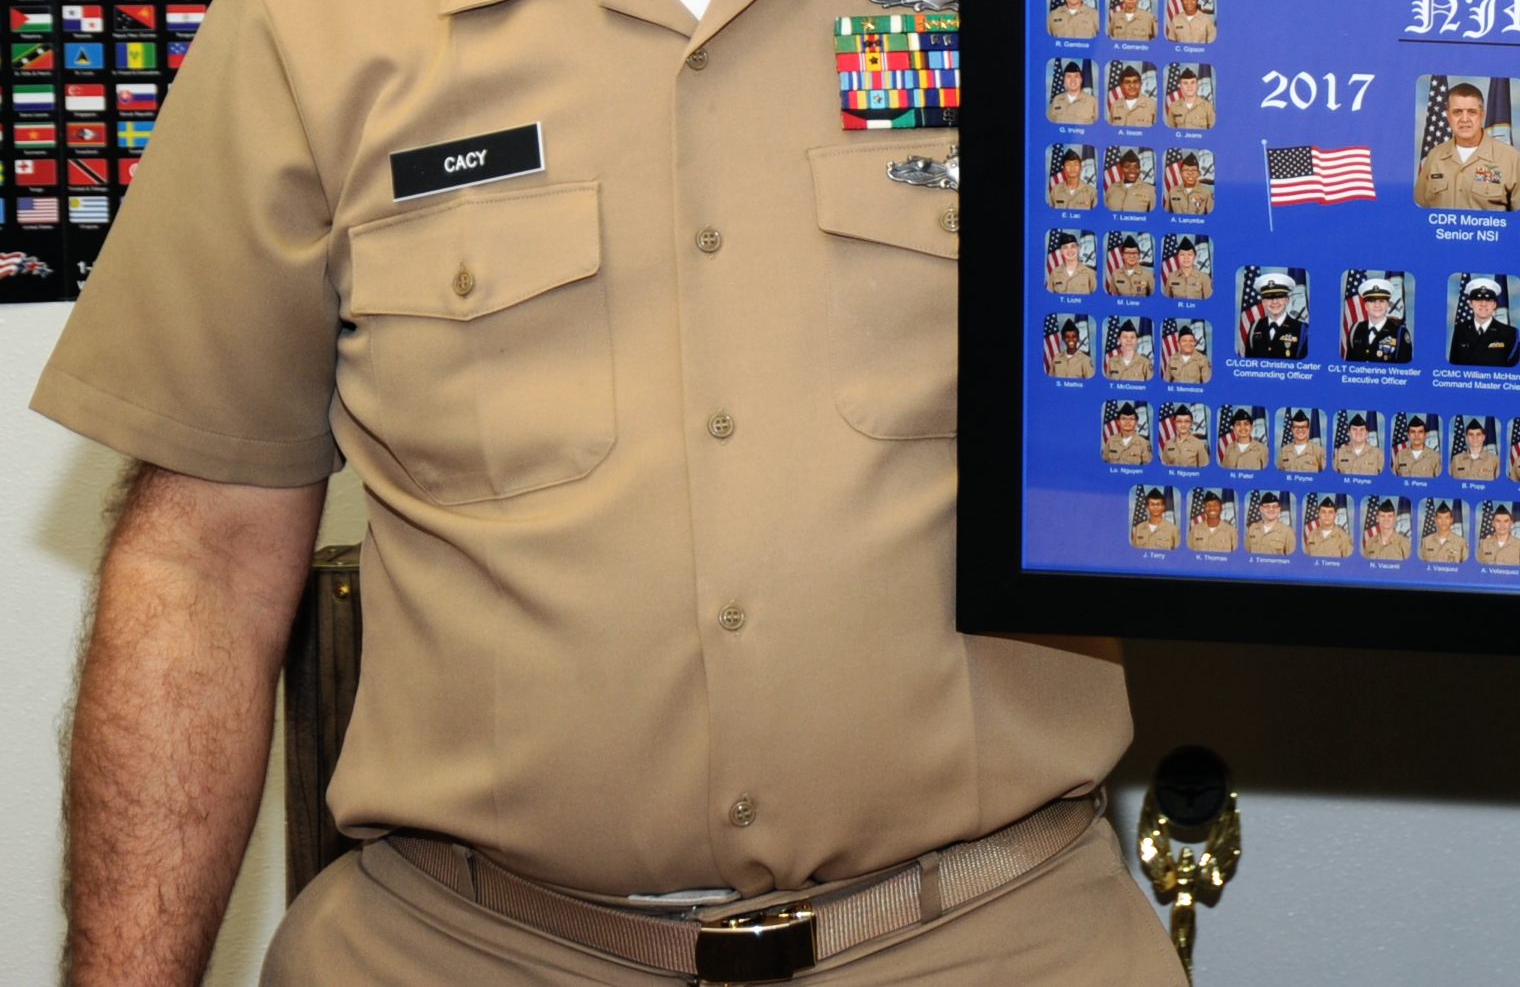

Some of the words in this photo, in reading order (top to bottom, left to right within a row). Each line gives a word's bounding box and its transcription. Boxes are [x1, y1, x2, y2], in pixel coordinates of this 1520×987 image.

[1260, 70, 1376, 112] 2017
[444, 148, 488, 173] CACY
[1428, 212, 1456, 225] CDR
[1460, 214, 1506, 227] Morales
[1436, 228, 1474, 241] Senior
[1476, 229, 1498, 242] NSI
[1225, 358, 1258, 368] C/LCDR
[1259, 360, 1294, 369] Christina
[1296, 361, 1320, 370] Carter
[1327, 364, 1347, 372] C/LT
[1348, 365, 1387, 374] Catherine
[1388, 367, 1421, 376] Wrestler
[1233, 368, 1285, 380] Commanding
[1286, 370, 1312, 380] Officer
[1341, 374, 1379, 384] Executive
[1380, 376, 1407, 385] Officer
[1432, 368, 1461, 378] C/CMC
[1462, 370, 1491, 379] William
[1432, 378, 1472, 388] Command
[1474, 380, 1501, 389] Master
